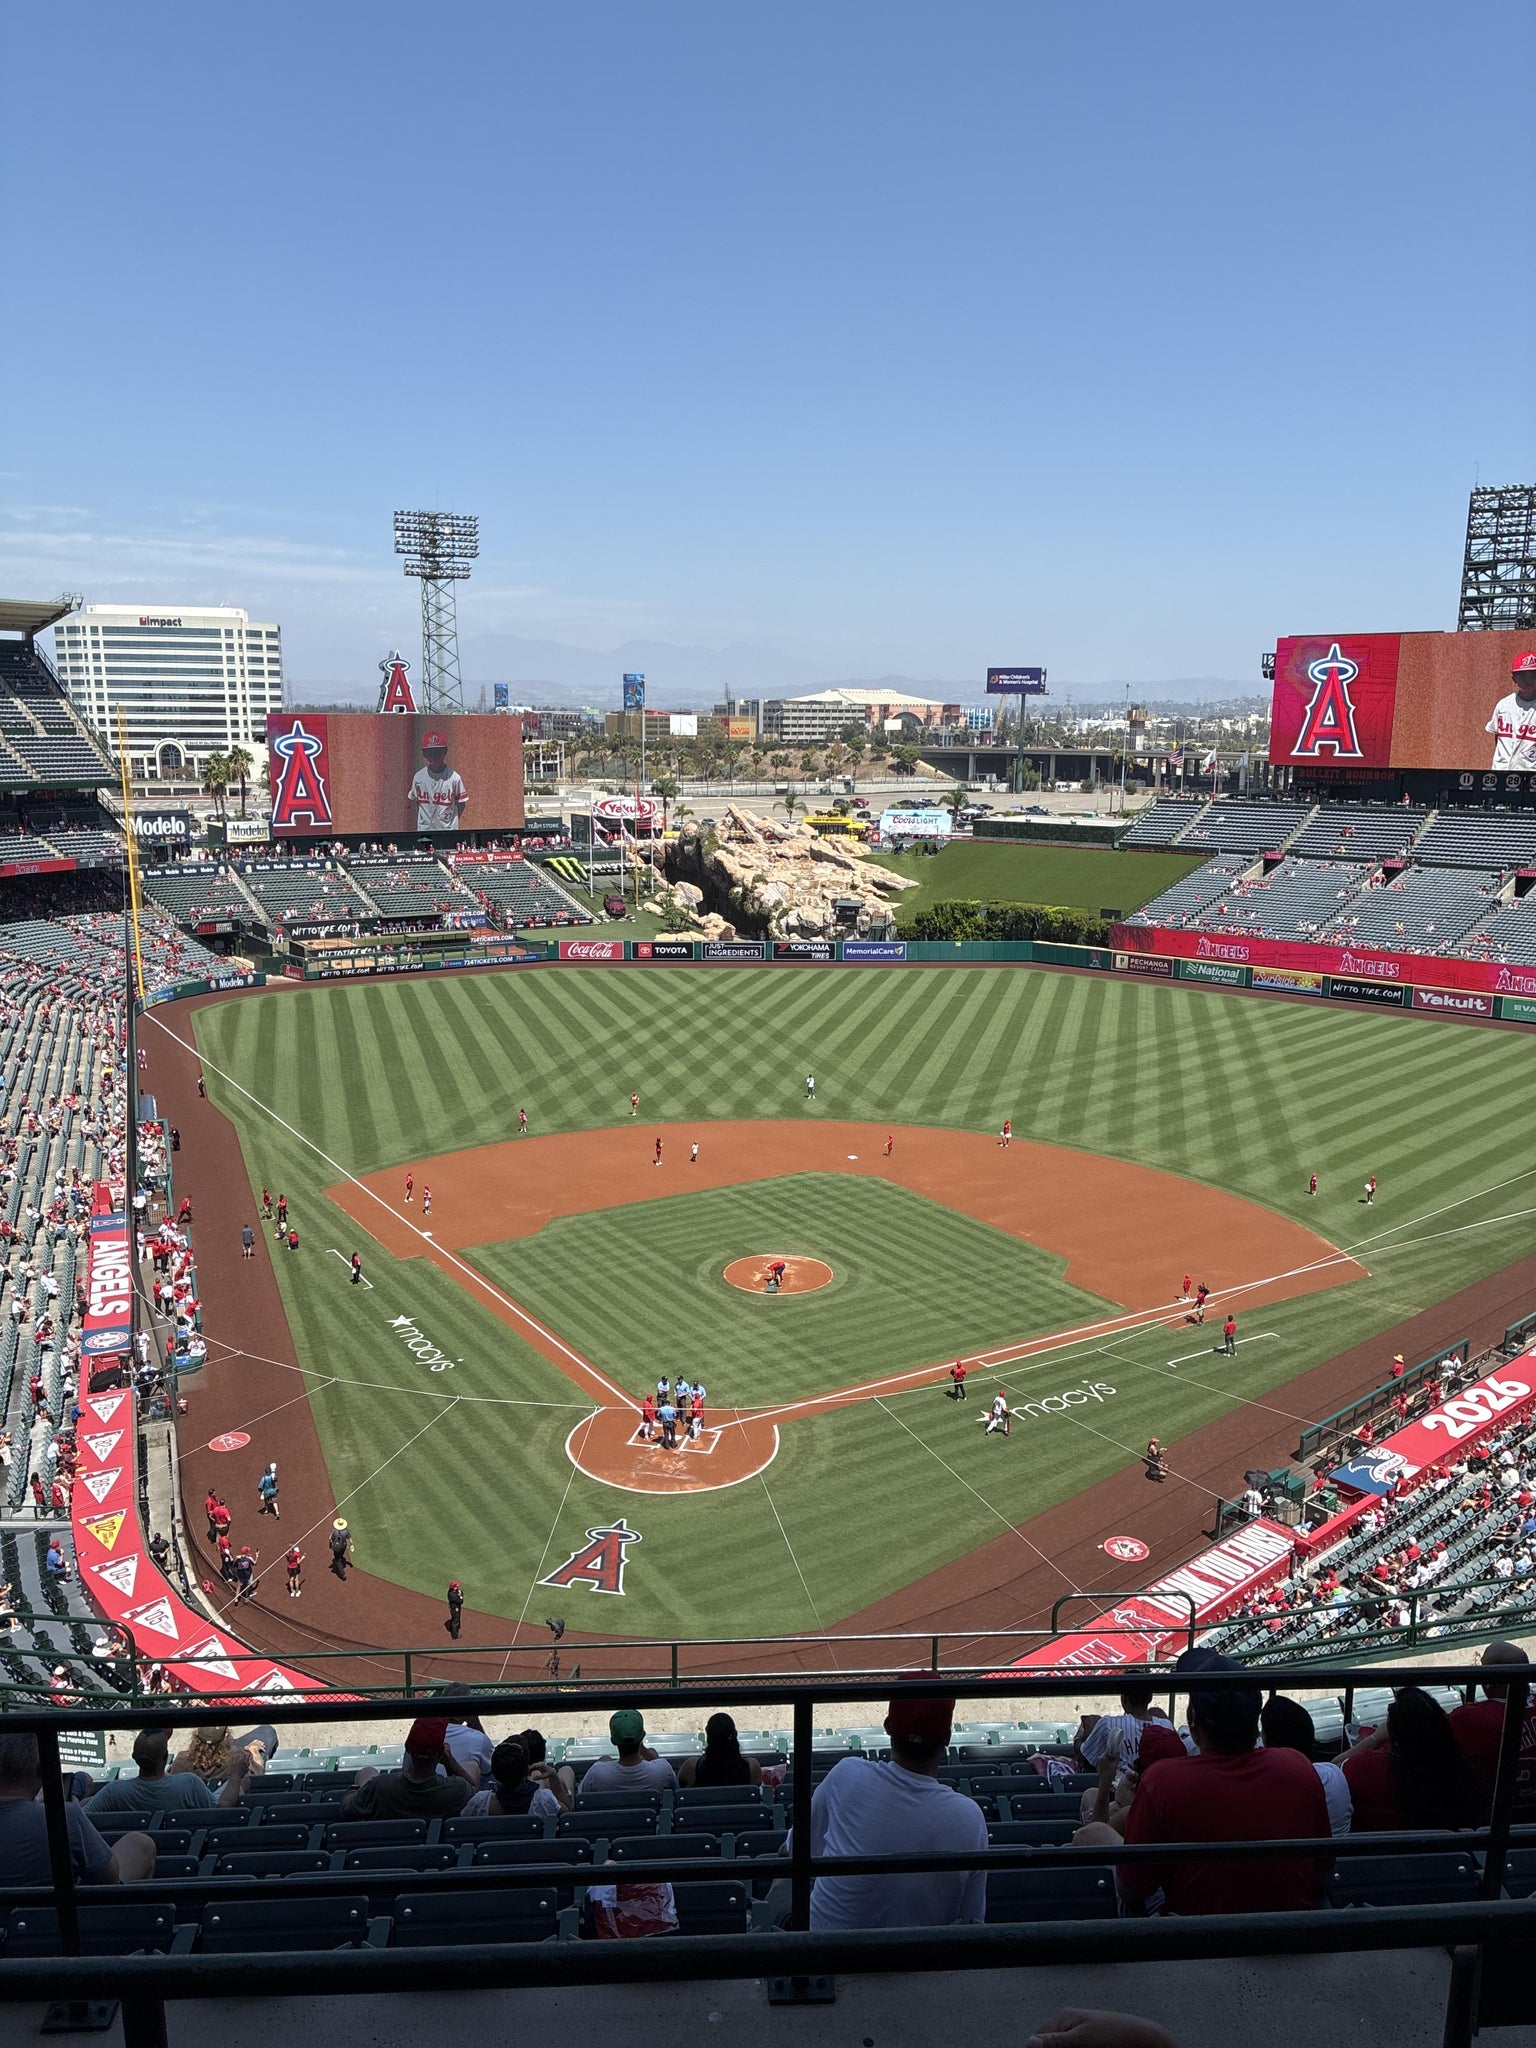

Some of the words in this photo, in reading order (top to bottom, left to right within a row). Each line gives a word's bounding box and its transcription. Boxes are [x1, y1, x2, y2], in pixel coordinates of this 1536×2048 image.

[129, 816, 186, 836] Modelo
[892, 815, 915, 824] Coors
[232, 825, 264, 836] Modelo
[567, 942, 615, 958] Coca-Cola
[846, 947, 894, 955] MemorialCare
[1196, 936, 1249, 961] ANGELS
[396, 963, 424, 971] TIRE.COM
[463, 957, 513, 966] 714TICKETS.COM
[1130, 958, 1169, 969] PECHANGA
[1339, 951, 1400, 978] ANGELS
[342, 967, 370, 975] TIRE.COM
[1198, 965, 1240, 978] National
[219, 977, 244, 989] Modelo
[1256, 972, 1296, 987] Surfside
[1332, 983, 1359, 994] NITTO
[1360, 987, 1402, 999] TIRE.COM
[1418, 992, 1488, 1011] Yakult
[89, 1240, 130, 1317] ANGELS
[1421, 1376, 1531, 1439] 2026
[1219, 1524, 1295, 1567] FANS!
[1188, 1549, 1255, 1586] YOU
[1135, 1568, 1226, 1620] THANK
